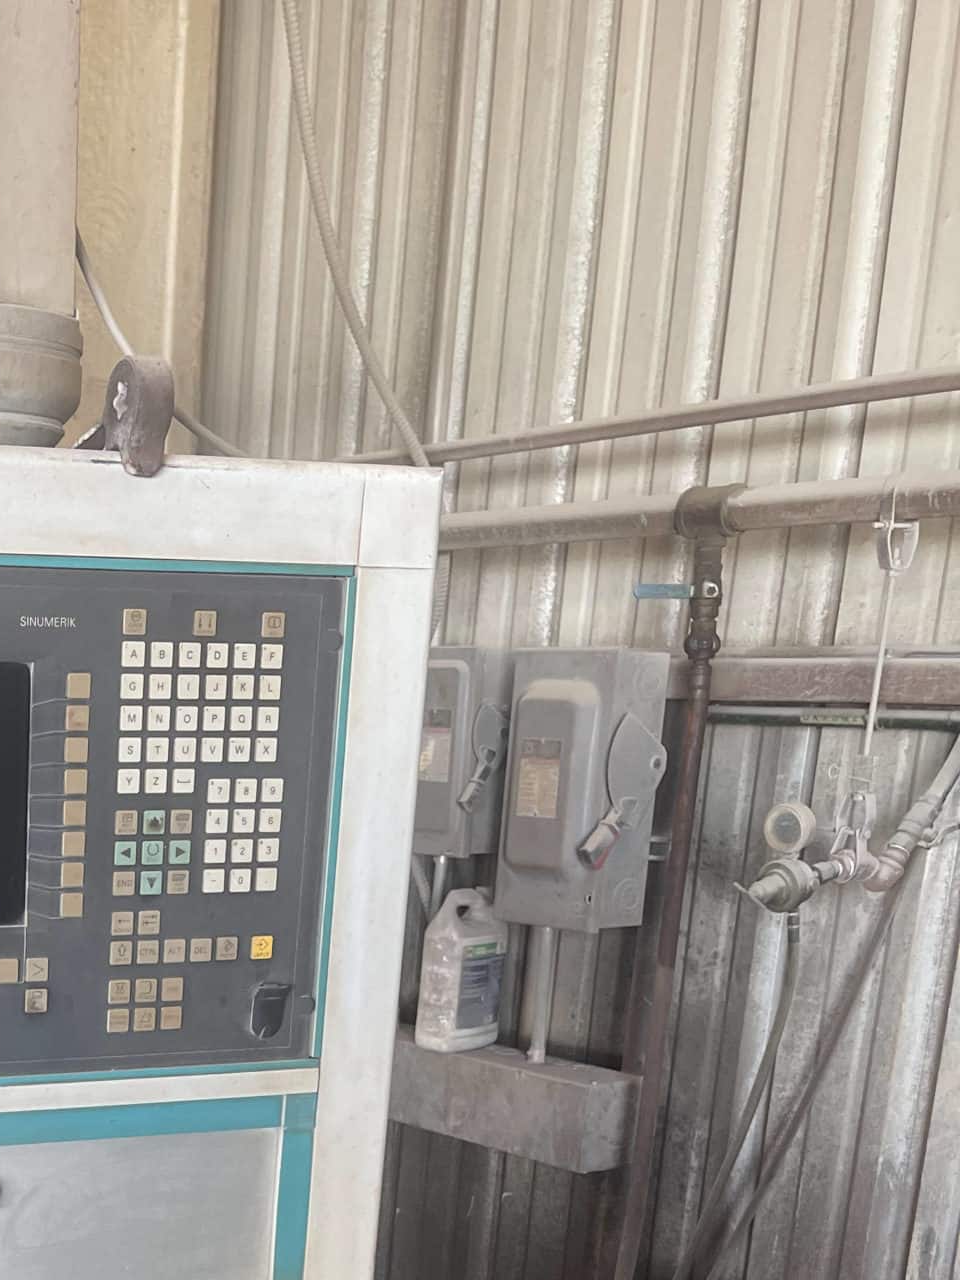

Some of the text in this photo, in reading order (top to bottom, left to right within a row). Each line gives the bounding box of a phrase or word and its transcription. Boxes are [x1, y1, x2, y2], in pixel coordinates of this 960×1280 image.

[19, 615, 76, 628] SINUMERIK
[168, 946, 182, 955] ALT
[193, 946, 209, 954] DEL
